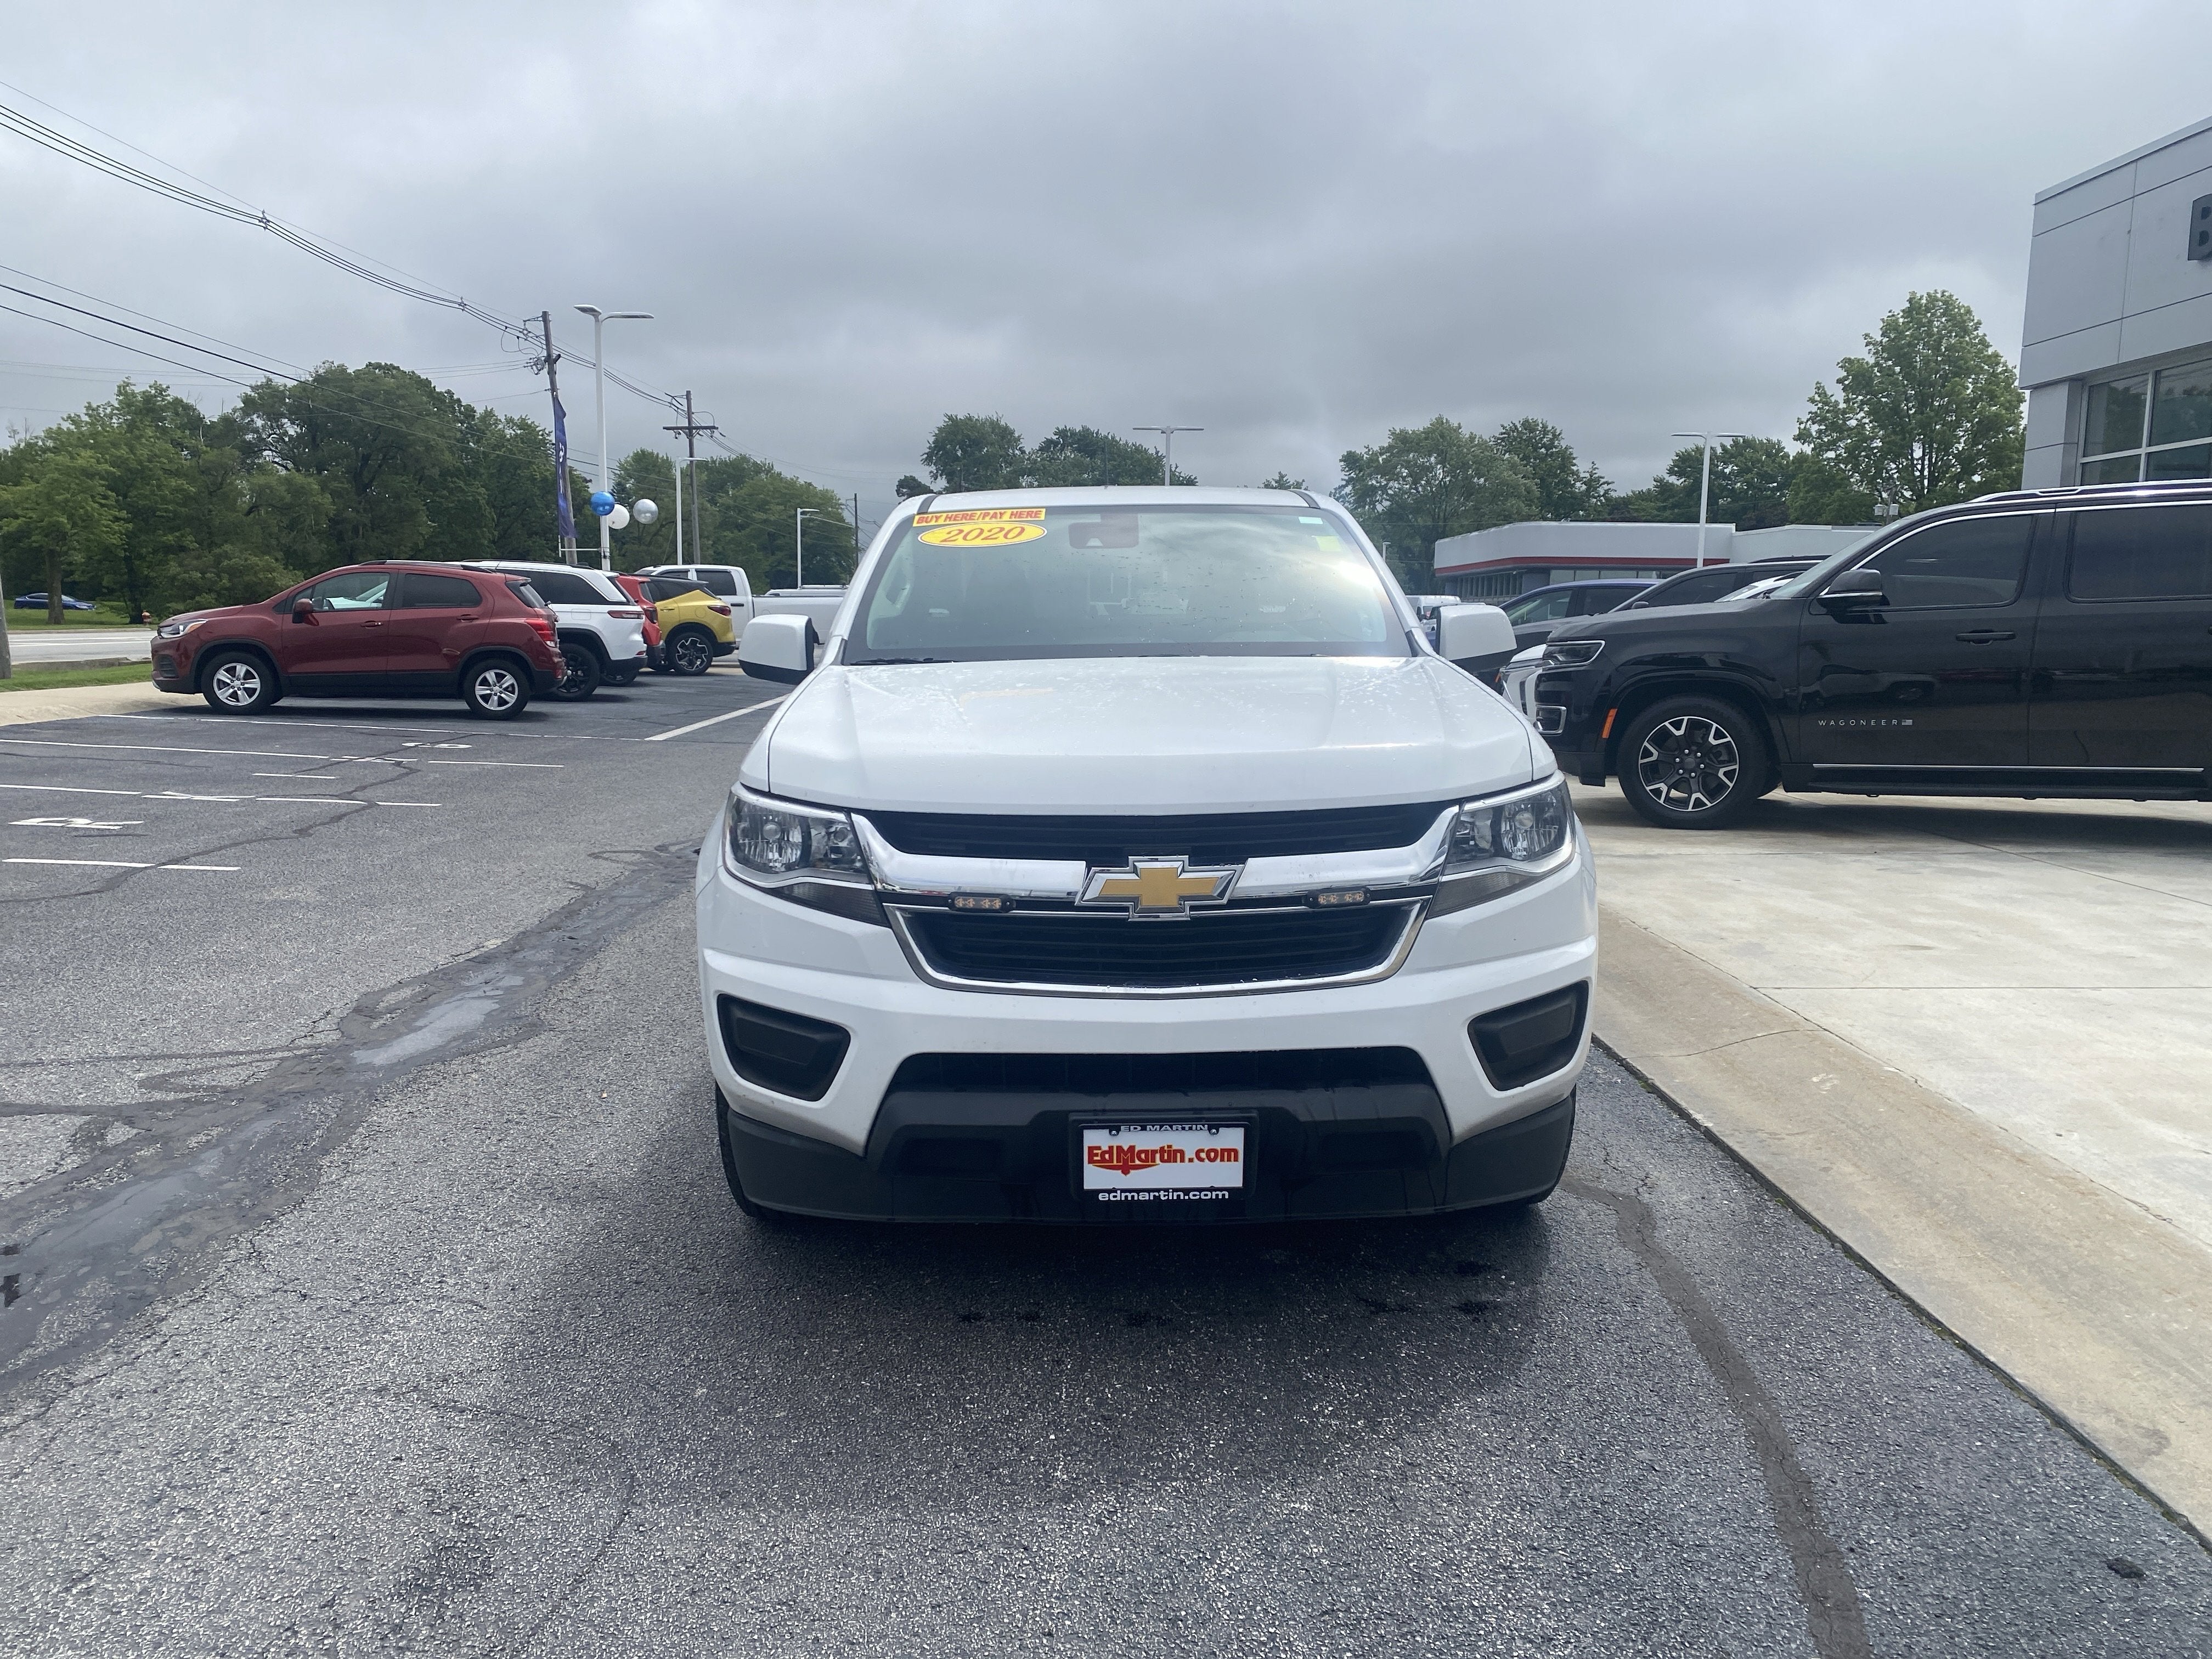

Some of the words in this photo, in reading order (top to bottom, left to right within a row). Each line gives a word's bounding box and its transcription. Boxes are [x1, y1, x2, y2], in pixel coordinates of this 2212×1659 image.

[917, 515, 943, 524] BUY
[944, 511, 1006, 522] HERE/PAY
[1009, 510, 1042, 520] HERE
[939, 526, 1025, 543] 2020
[1087, 1144, 1239, 1167] EdMartin.com
[1098, 1189, 1229, 1200] edmartin.com
